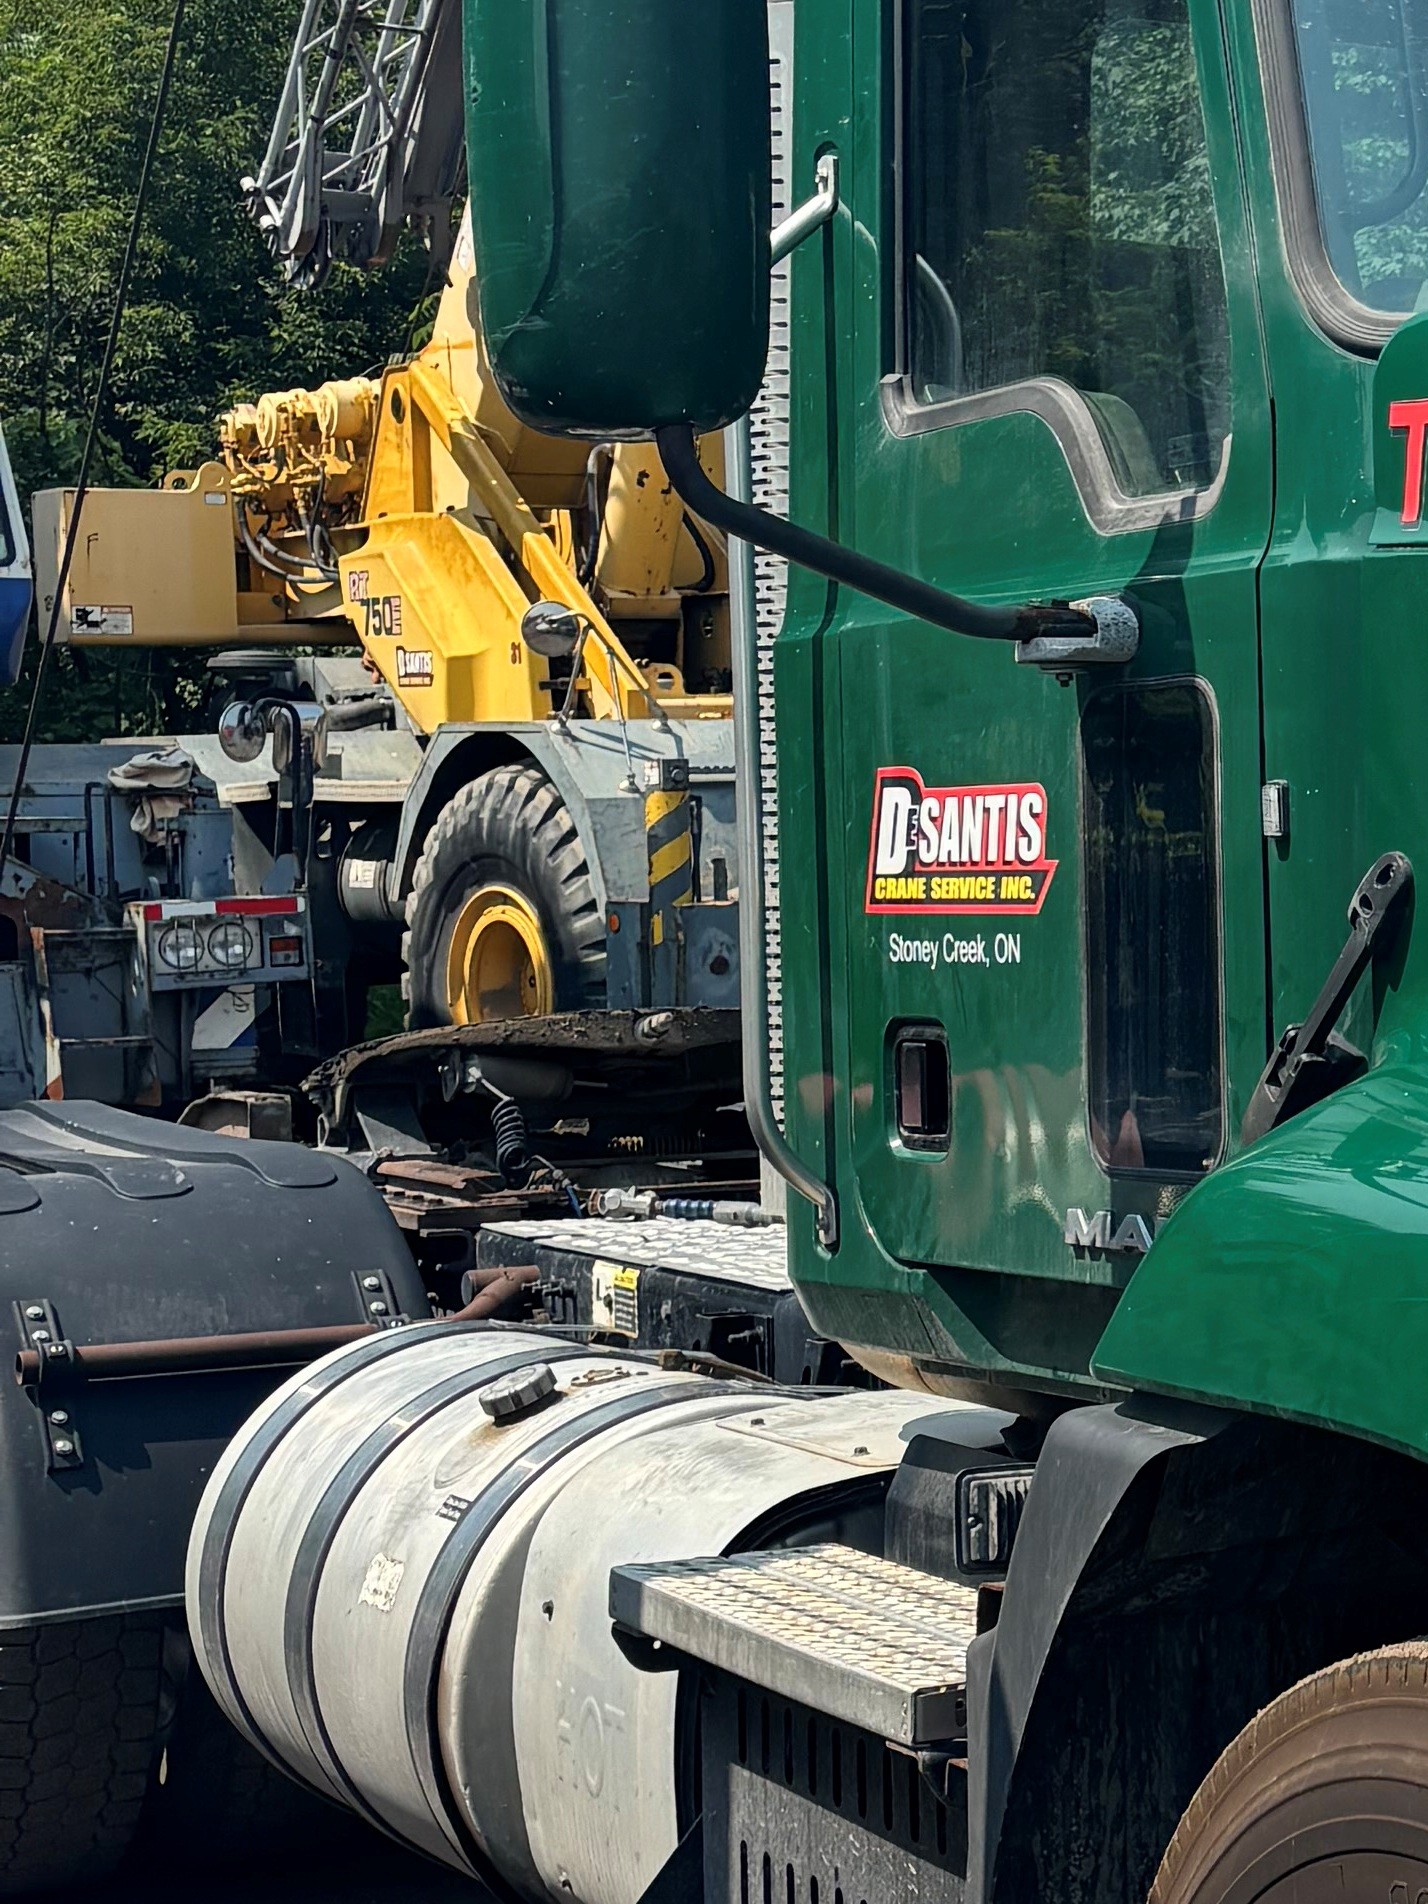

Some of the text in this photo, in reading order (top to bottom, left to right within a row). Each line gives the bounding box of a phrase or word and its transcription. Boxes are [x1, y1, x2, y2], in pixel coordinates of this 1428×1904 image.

[874, 876, 1036, 900] CRANE SERVICE INC.
[889, 932, 1021, 970] Stoney Creek, ON
[1064, 1207, 1168, 1252] MA
